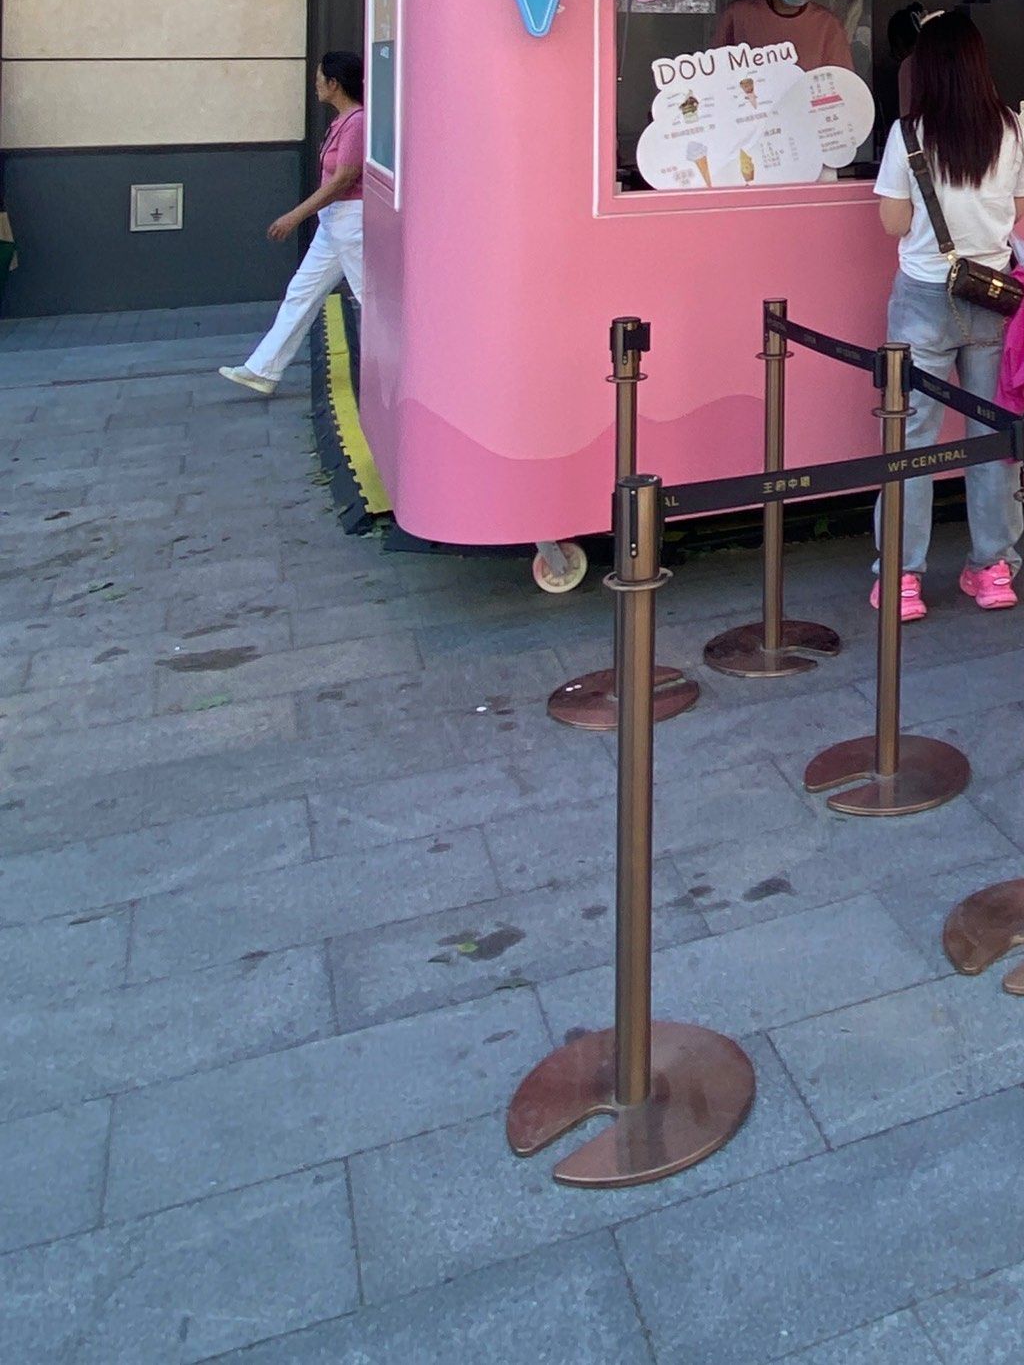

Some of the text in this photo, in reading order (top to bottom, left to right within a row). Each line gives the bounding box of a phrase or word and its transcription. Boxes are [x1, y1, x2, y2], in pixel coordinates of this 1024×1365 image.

[658, 46, 793, 85] DOU Menu
[888, 448, 968, 472] WF CENTRAL
